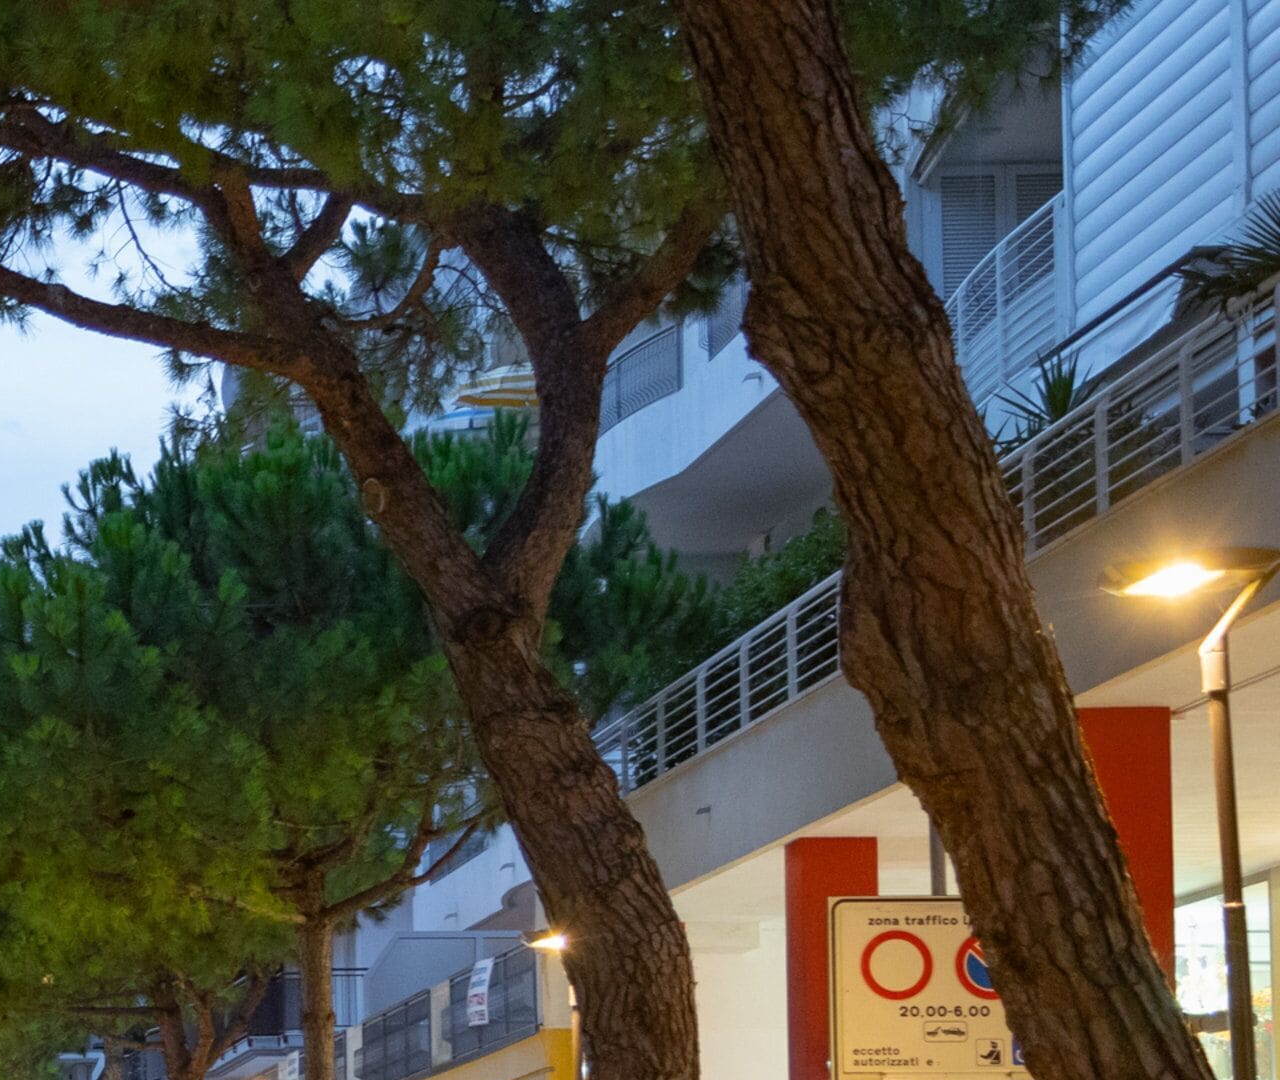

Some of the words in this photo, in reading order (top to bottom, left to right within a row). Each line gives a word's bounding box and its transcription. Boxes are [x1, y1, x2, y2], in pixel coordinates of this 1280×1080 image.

[868, 918, 900, 926] zona
[905, 915, 958, 926] traffico
[853, 1046, 900, 1056] eccetto
[853, 1056, 919, 1067] autorizzati
